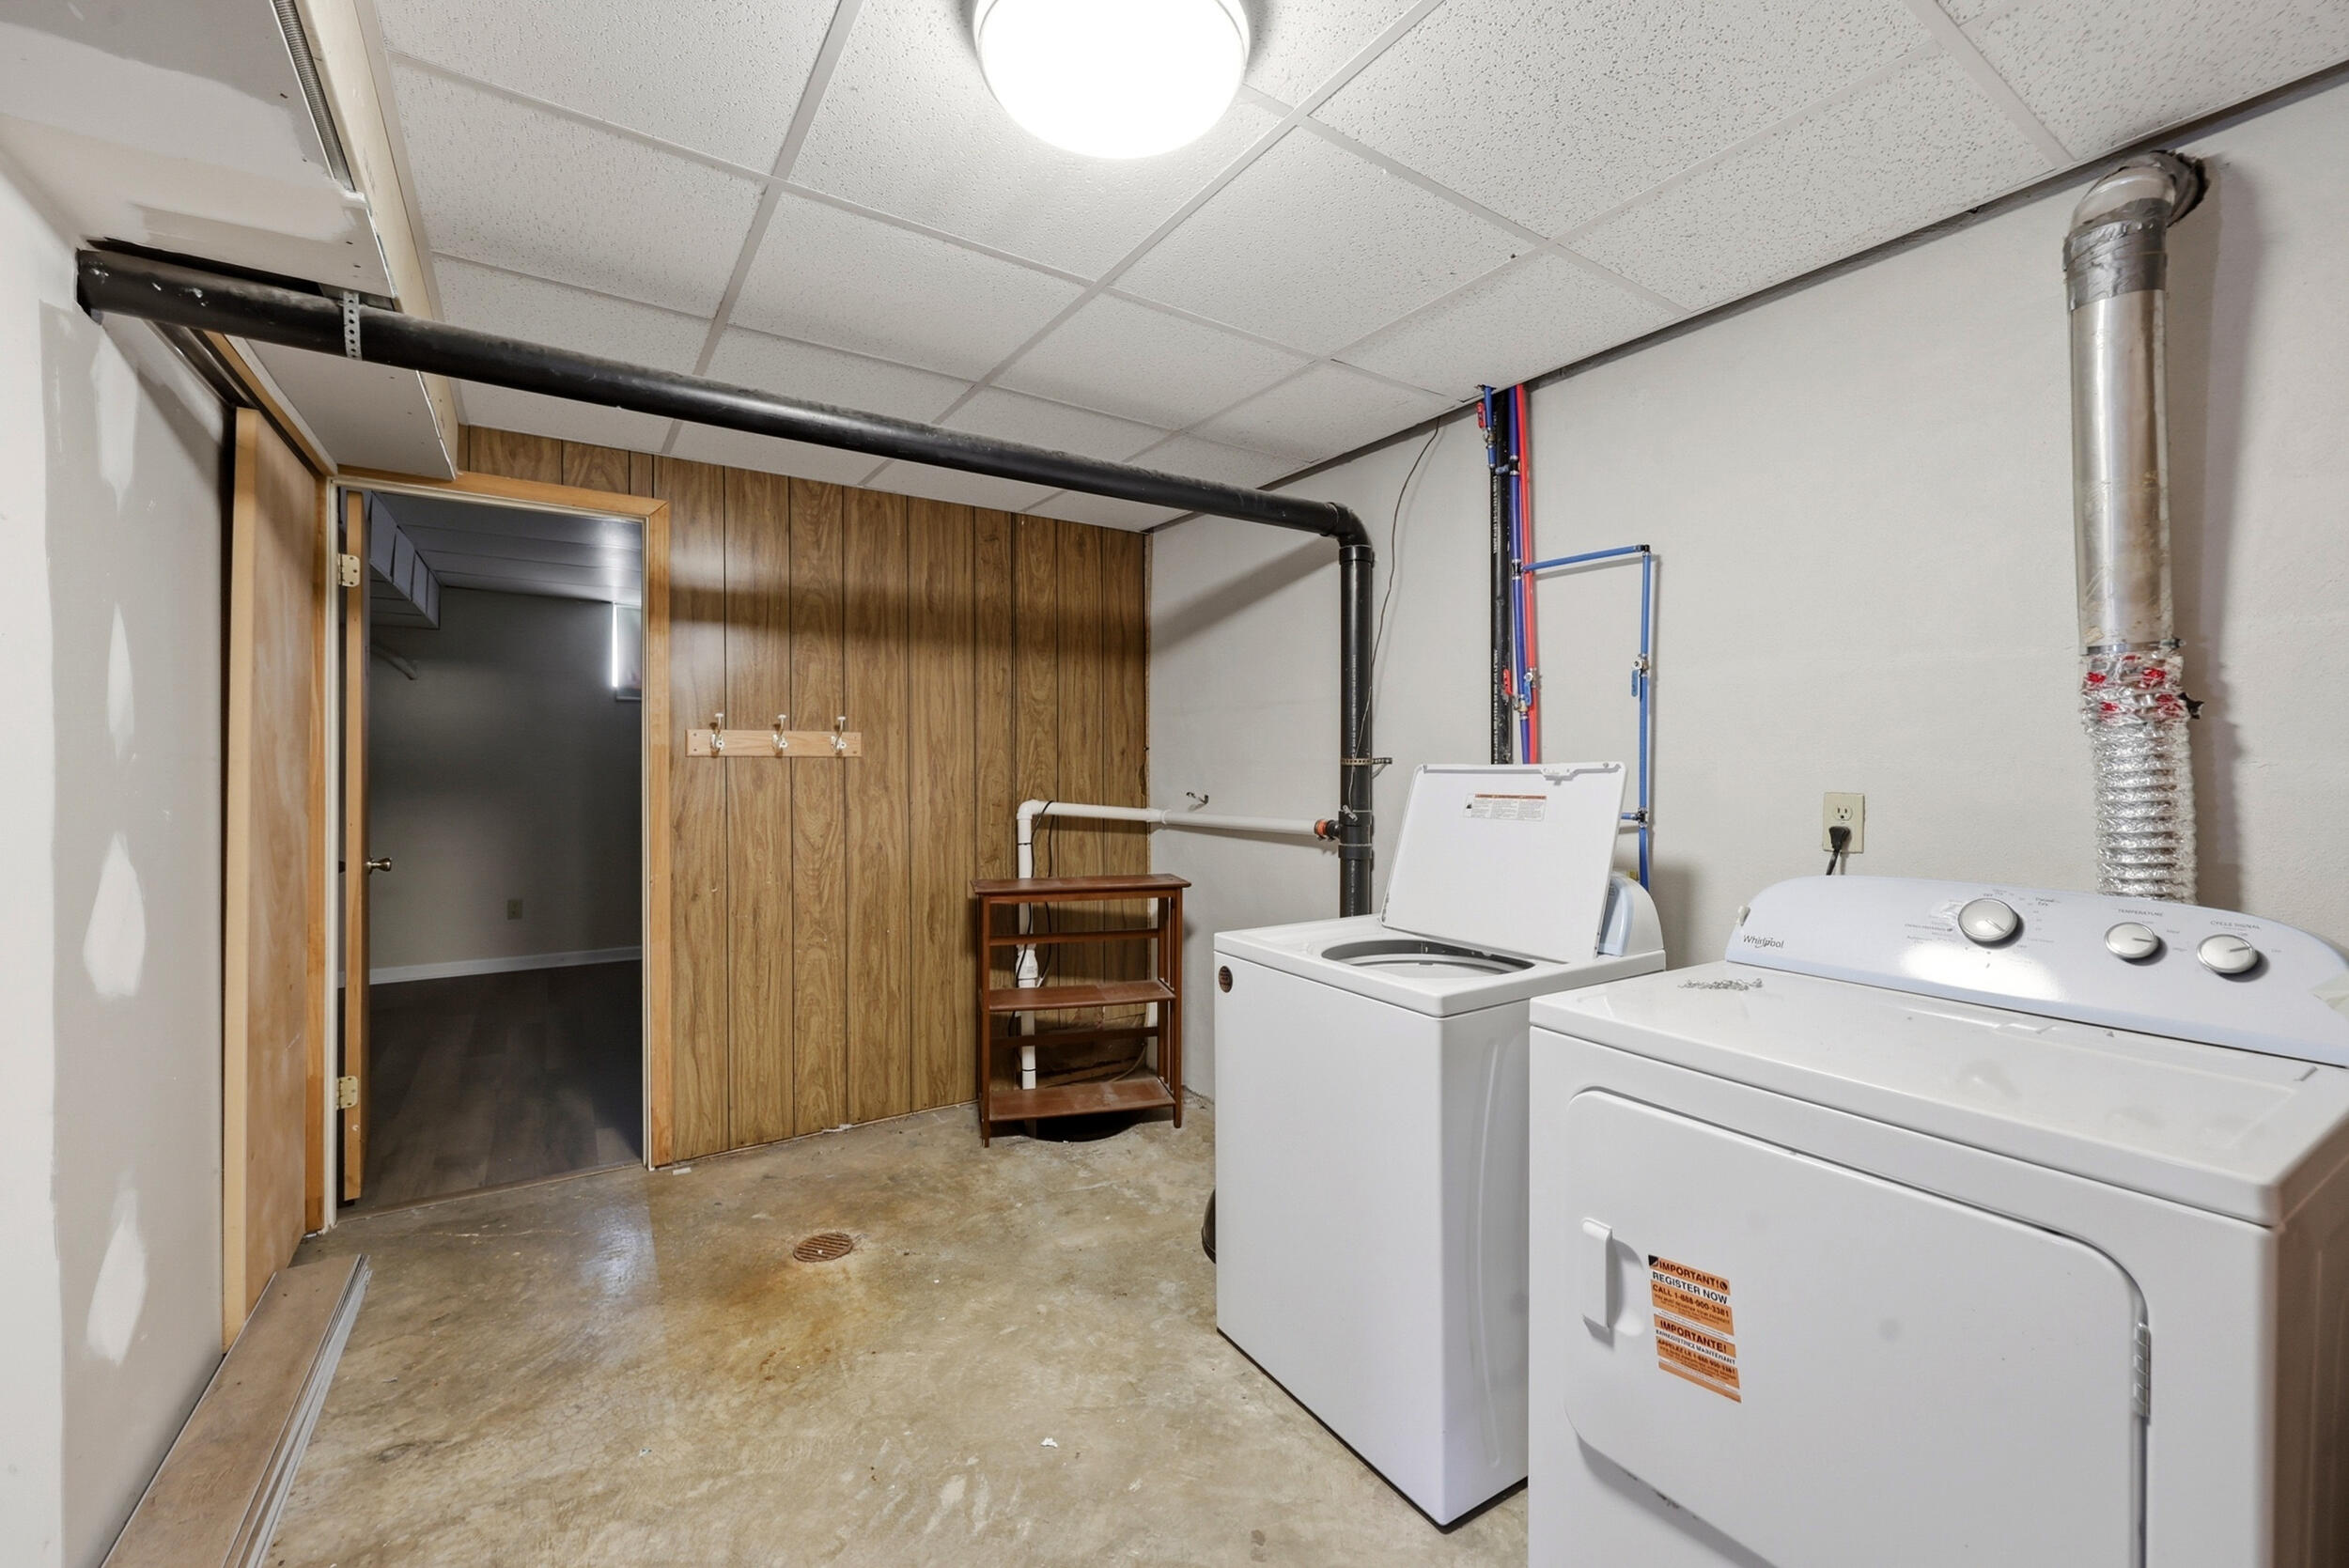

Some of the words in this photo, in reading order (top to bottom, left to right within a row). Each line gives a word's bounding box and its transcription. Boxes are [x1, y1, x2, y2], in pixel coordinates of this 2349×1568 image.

[1743, 934, 1785, 949] Whirlpool
[1652, 1271, 1701, 1296] REGISTER
[1703, 1288, 1728, 1305] NOW
[1659, 1260, 1719, 1288] IMPORTANT!
[1652, 1283, 1673, 1297] CALL
[1659, 1319, 1727, 1354] IMPORTANTE!
